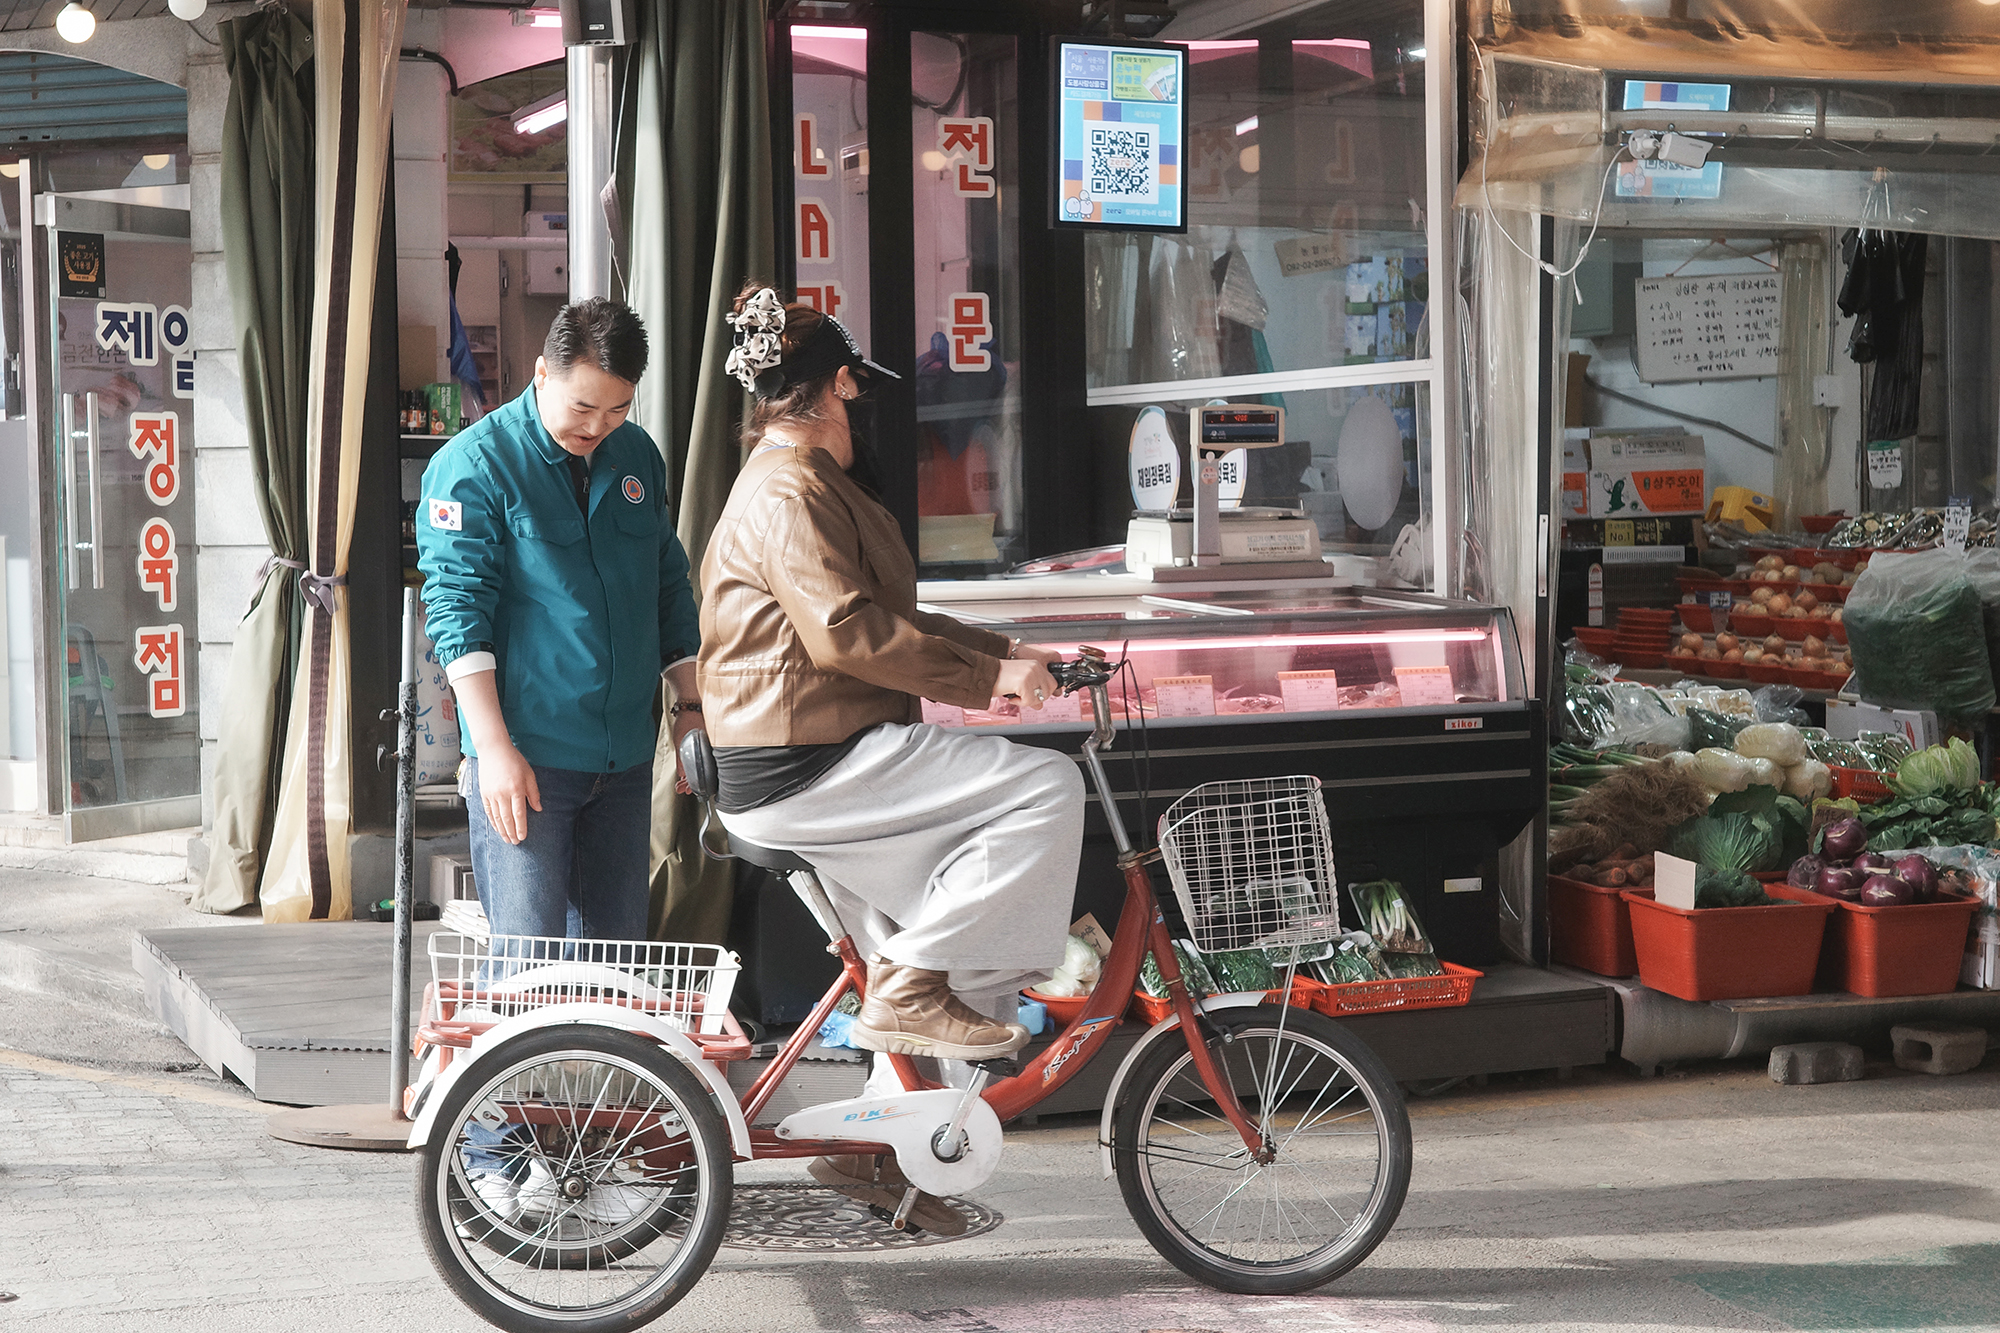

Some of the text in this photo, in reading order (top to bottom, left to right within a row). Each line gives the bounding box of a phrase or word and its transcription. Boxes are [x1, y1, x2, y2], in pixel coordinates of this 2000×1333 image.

[1137, 462, 1172, 489] 제일정육점
[1653, 475, 1700, 490] 상주오이
[843, 1105, 899, 1122] BIKE
